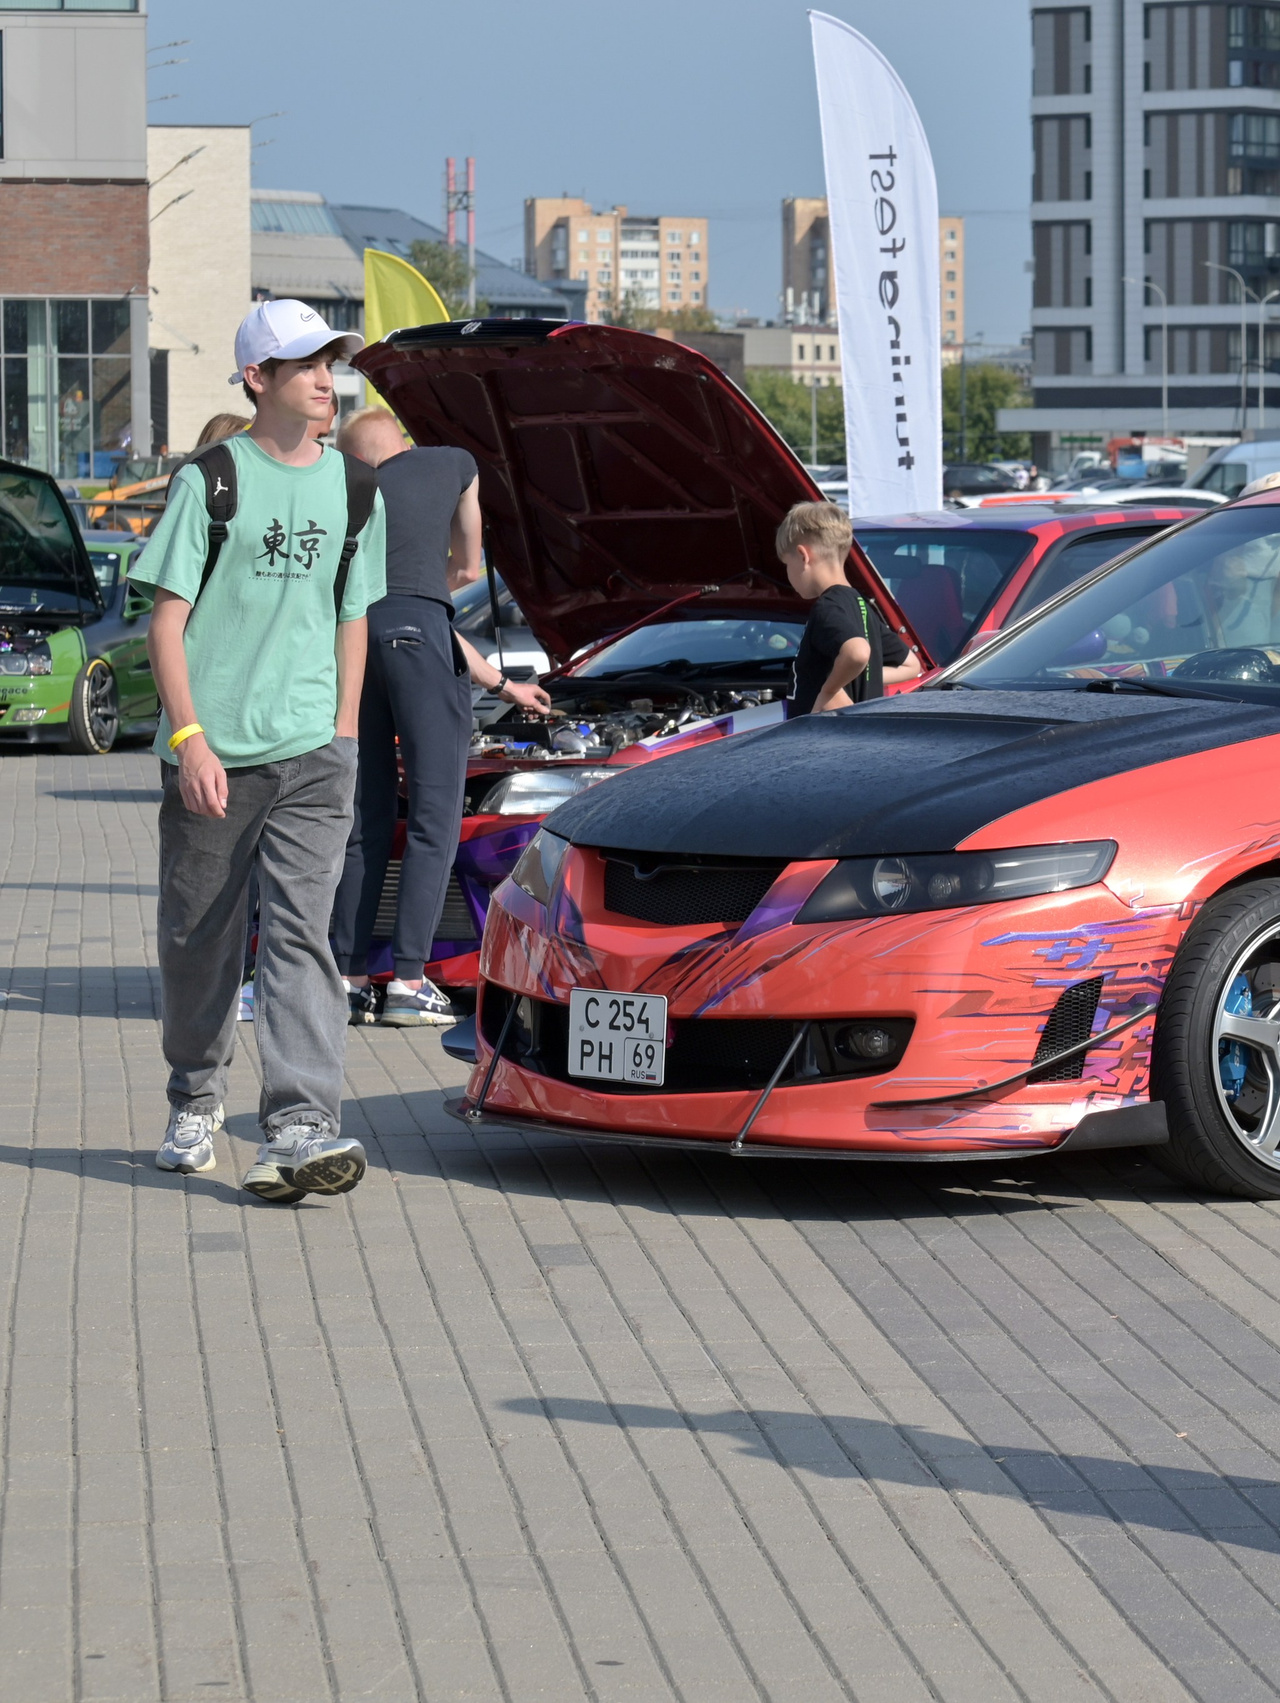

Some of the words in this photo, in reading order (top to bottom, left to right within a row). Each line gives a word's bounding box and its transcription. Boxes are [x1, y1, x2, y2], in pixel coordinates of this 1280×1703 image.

[254, 518, 328, 570] 東京
[608, 999, 650, 1034] 254
[632, 1043, 656, 1069] 69
[631, 1069, 646, 1079] RUS
